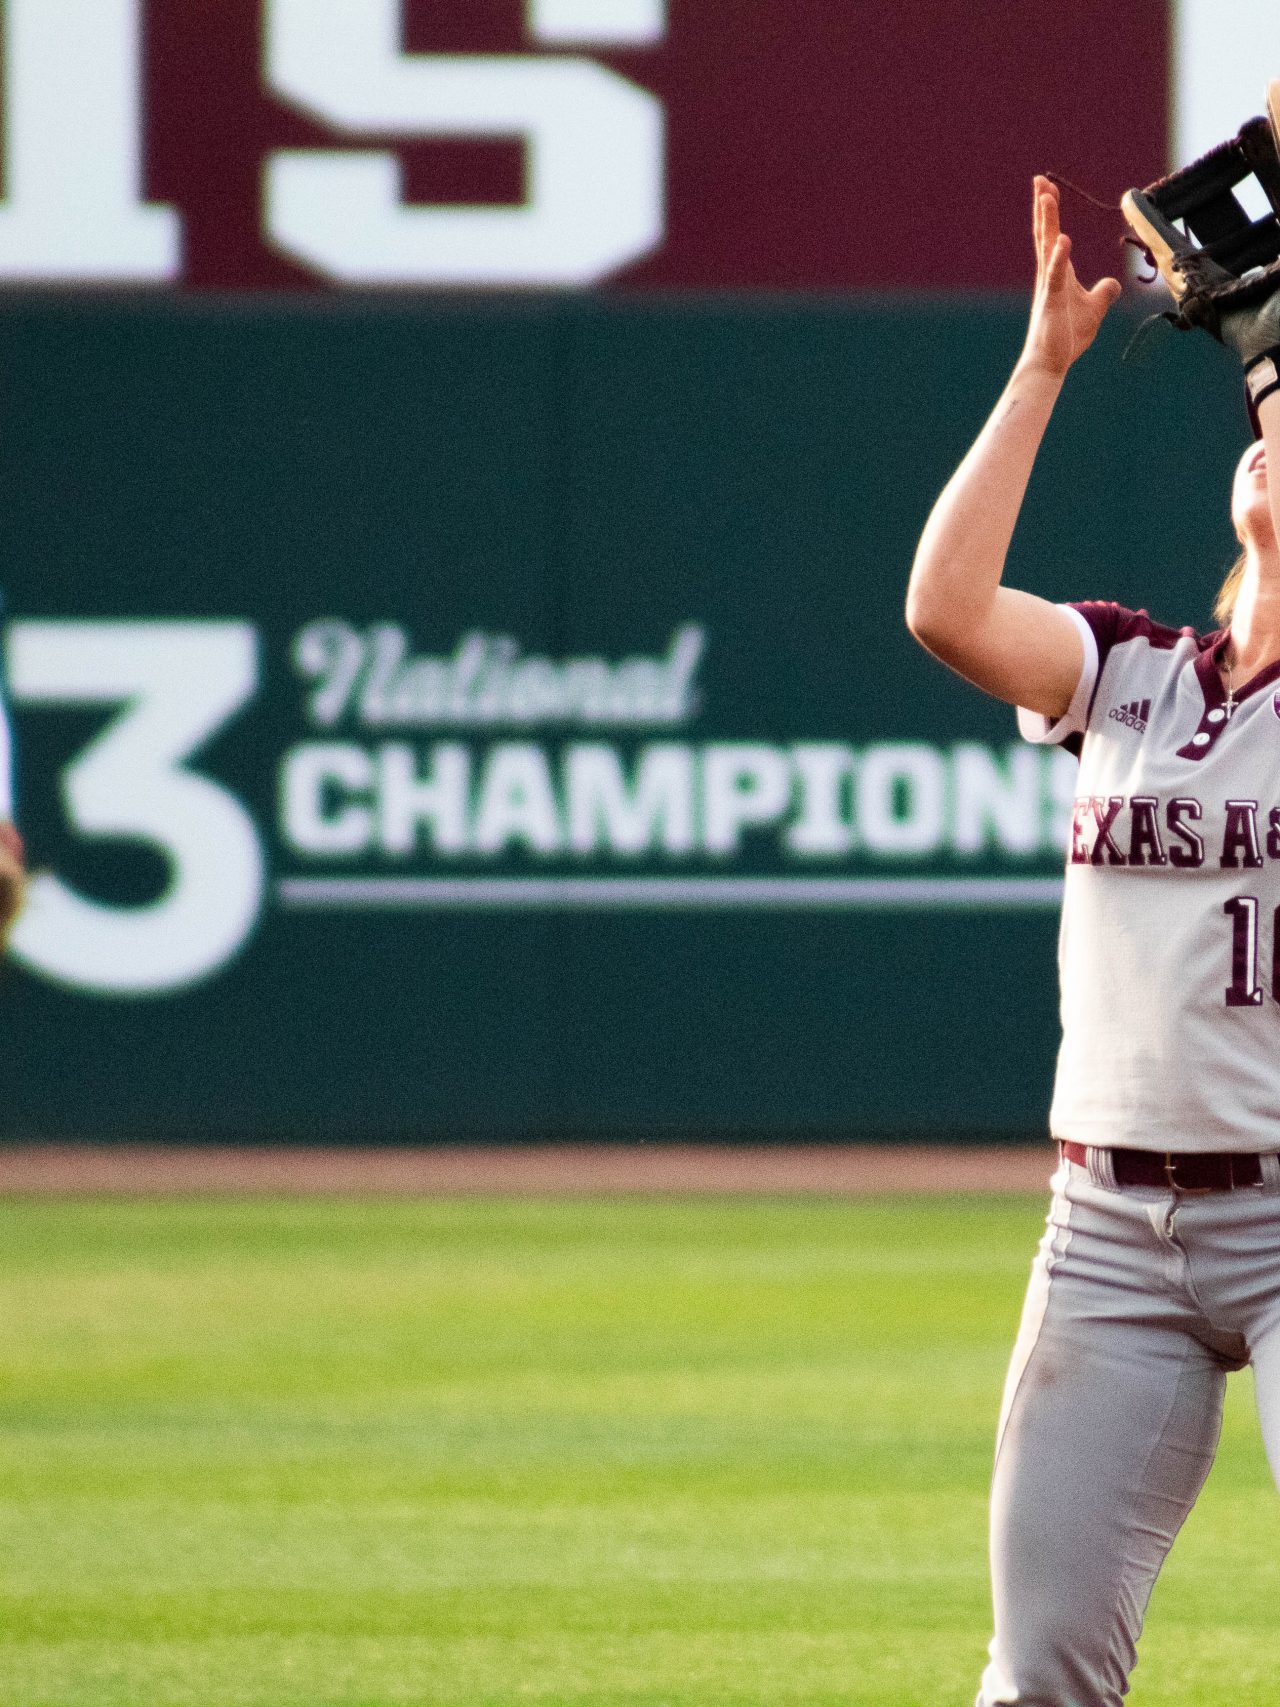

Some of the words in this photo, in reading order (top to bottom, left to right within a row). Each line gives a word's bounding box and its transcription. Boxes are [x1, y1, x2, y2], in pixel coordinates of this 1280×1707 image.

[293, 618, 706, 728] National
[1109, 706, 1146, 734] adidas
[6, 618, 265, 996] 3
[1071, 796, 1204, 867] EXAS
